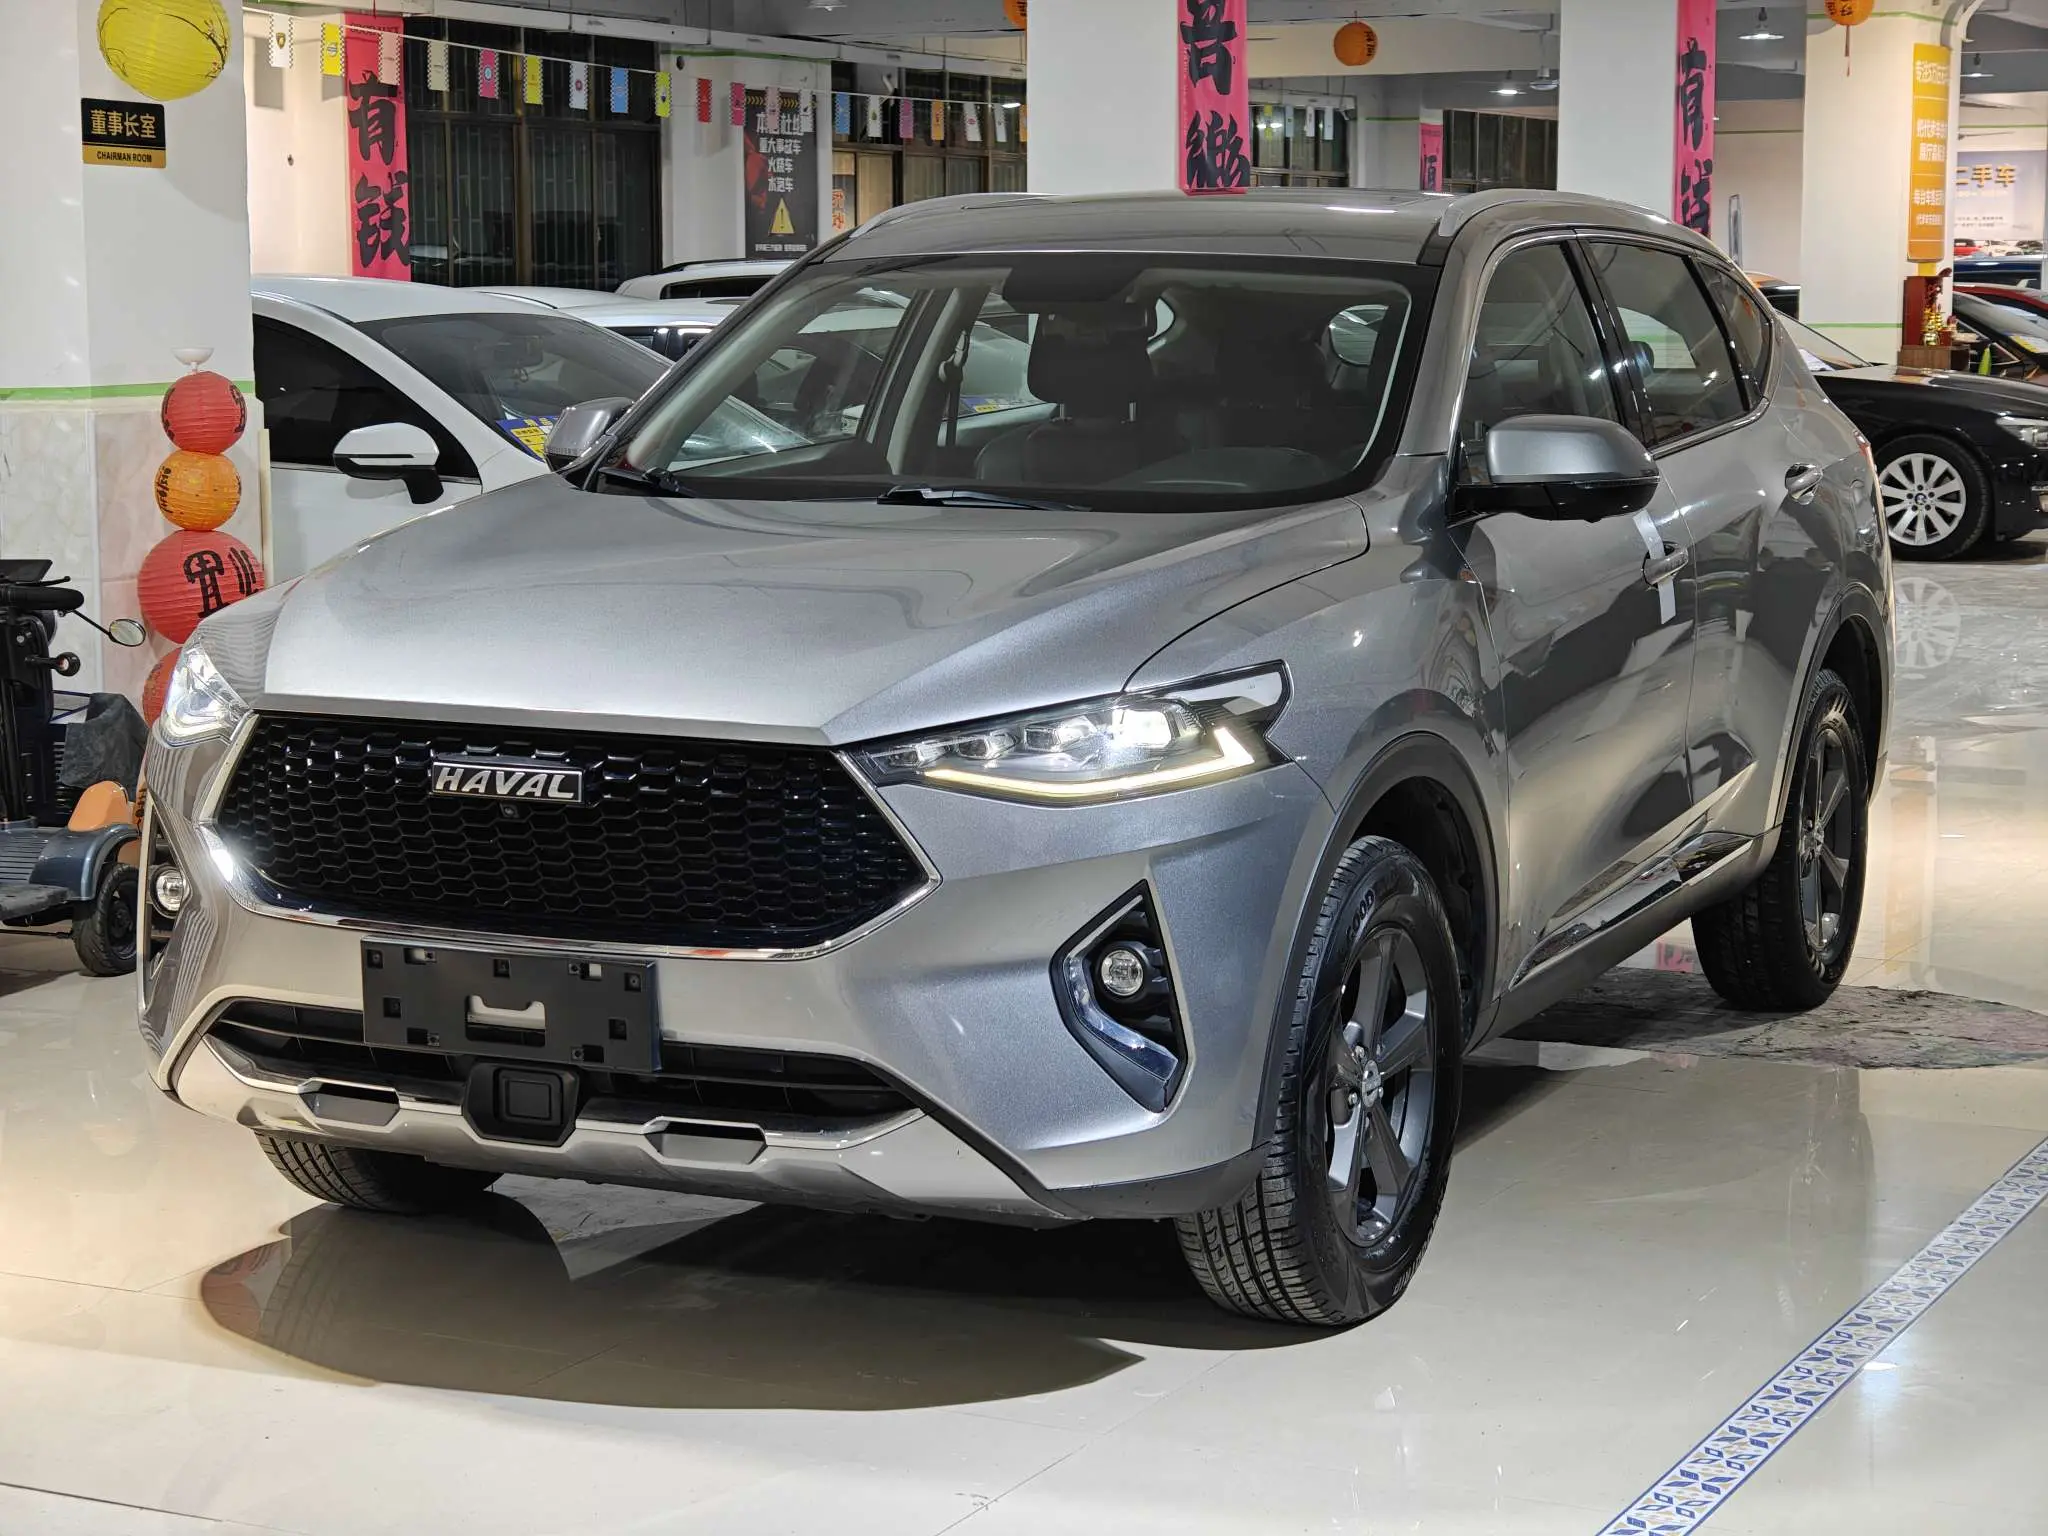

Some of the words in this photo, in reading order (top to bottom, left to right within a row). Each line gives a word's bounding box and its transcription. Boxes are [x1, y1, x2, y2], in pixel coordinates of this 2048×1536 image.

[90, 108, 157, 138] 董事长室
[96, 150, 132, 161] CHAIRMAN
[132, 152, 153, 163] ROOM
[435, 767, 574, 799] HAVAL
